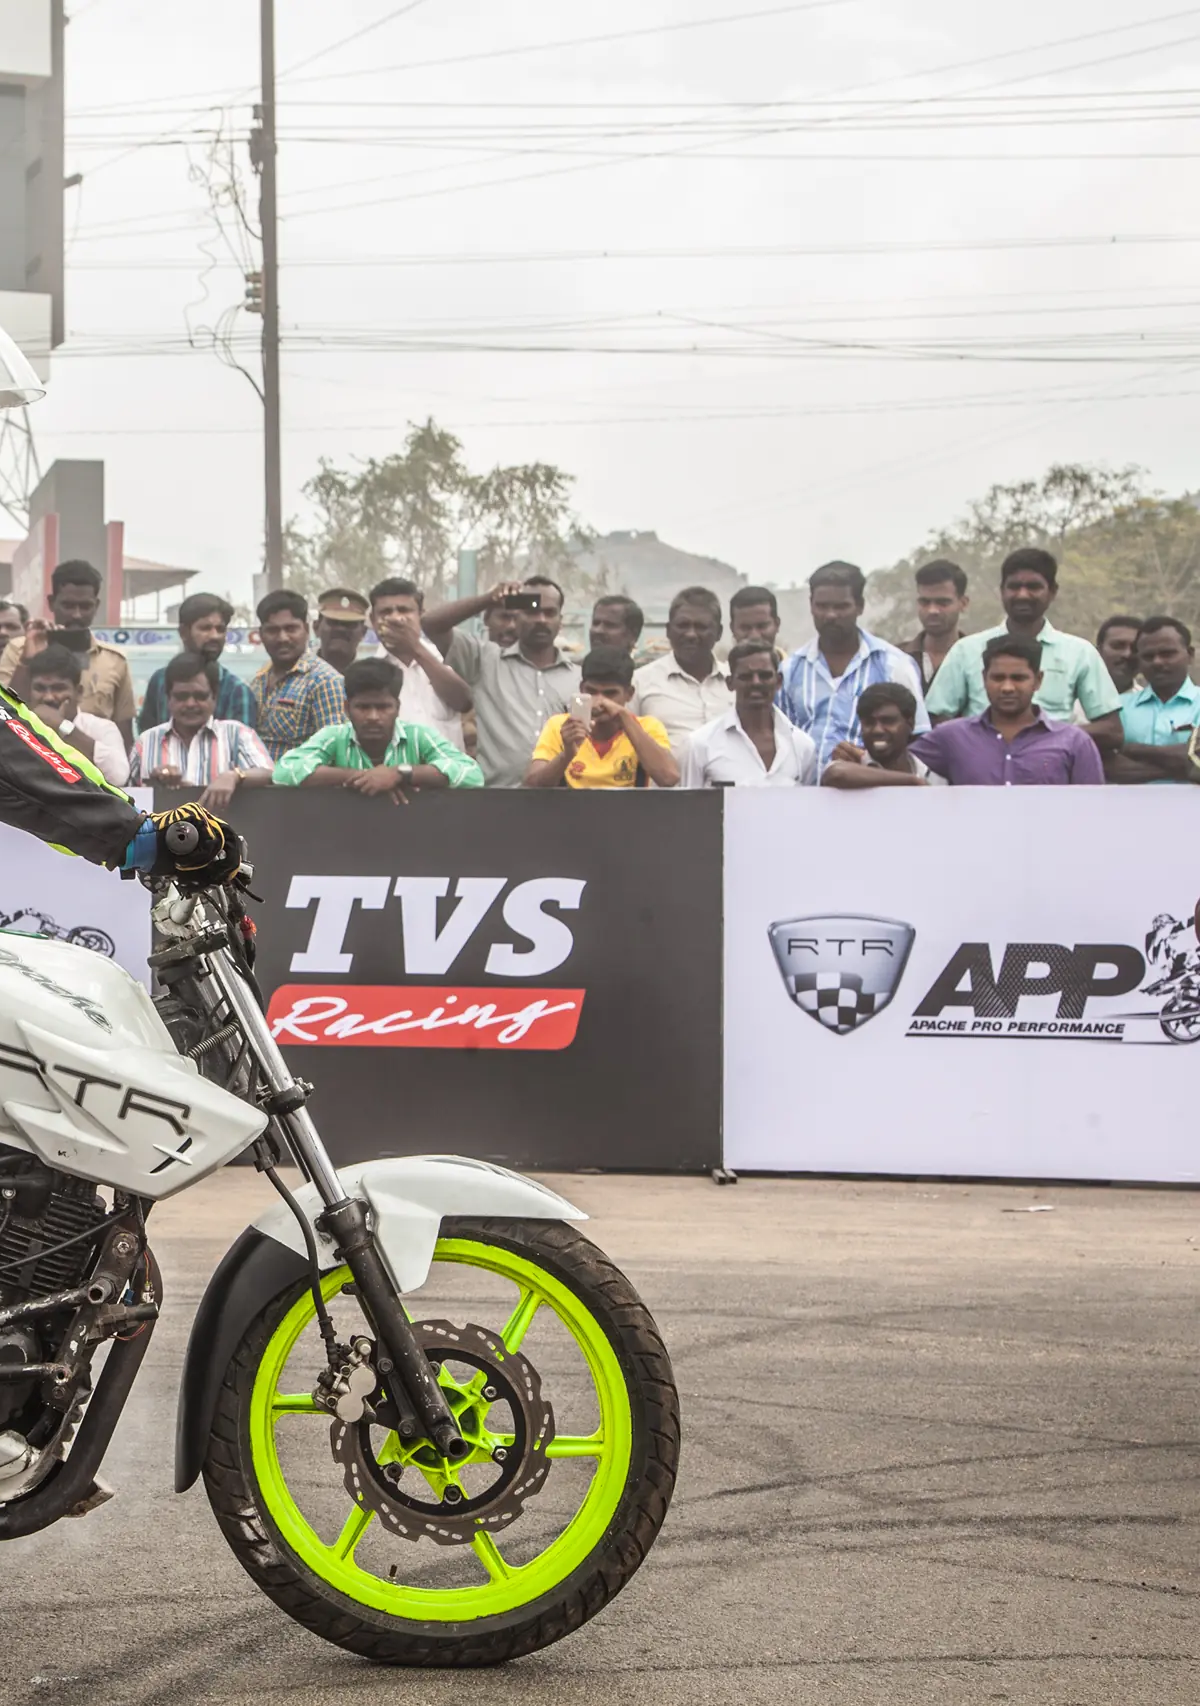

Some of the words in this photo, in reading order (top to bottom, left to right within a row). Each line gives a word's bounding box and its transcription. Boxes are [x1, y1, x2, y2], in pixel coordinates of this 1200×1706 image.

[285, 875, 587, 977] TVS
[787, 938, 895, 957] RTR
[911, 942, 1147, 1019] APP
[271, 995, 576, 1044] Racing
[908, 1020, 967, 1032] APACHE
[971, 1021, 1003, 1033] PRO
[1007, 1022, 1126, 1034] PERFORMANCE
